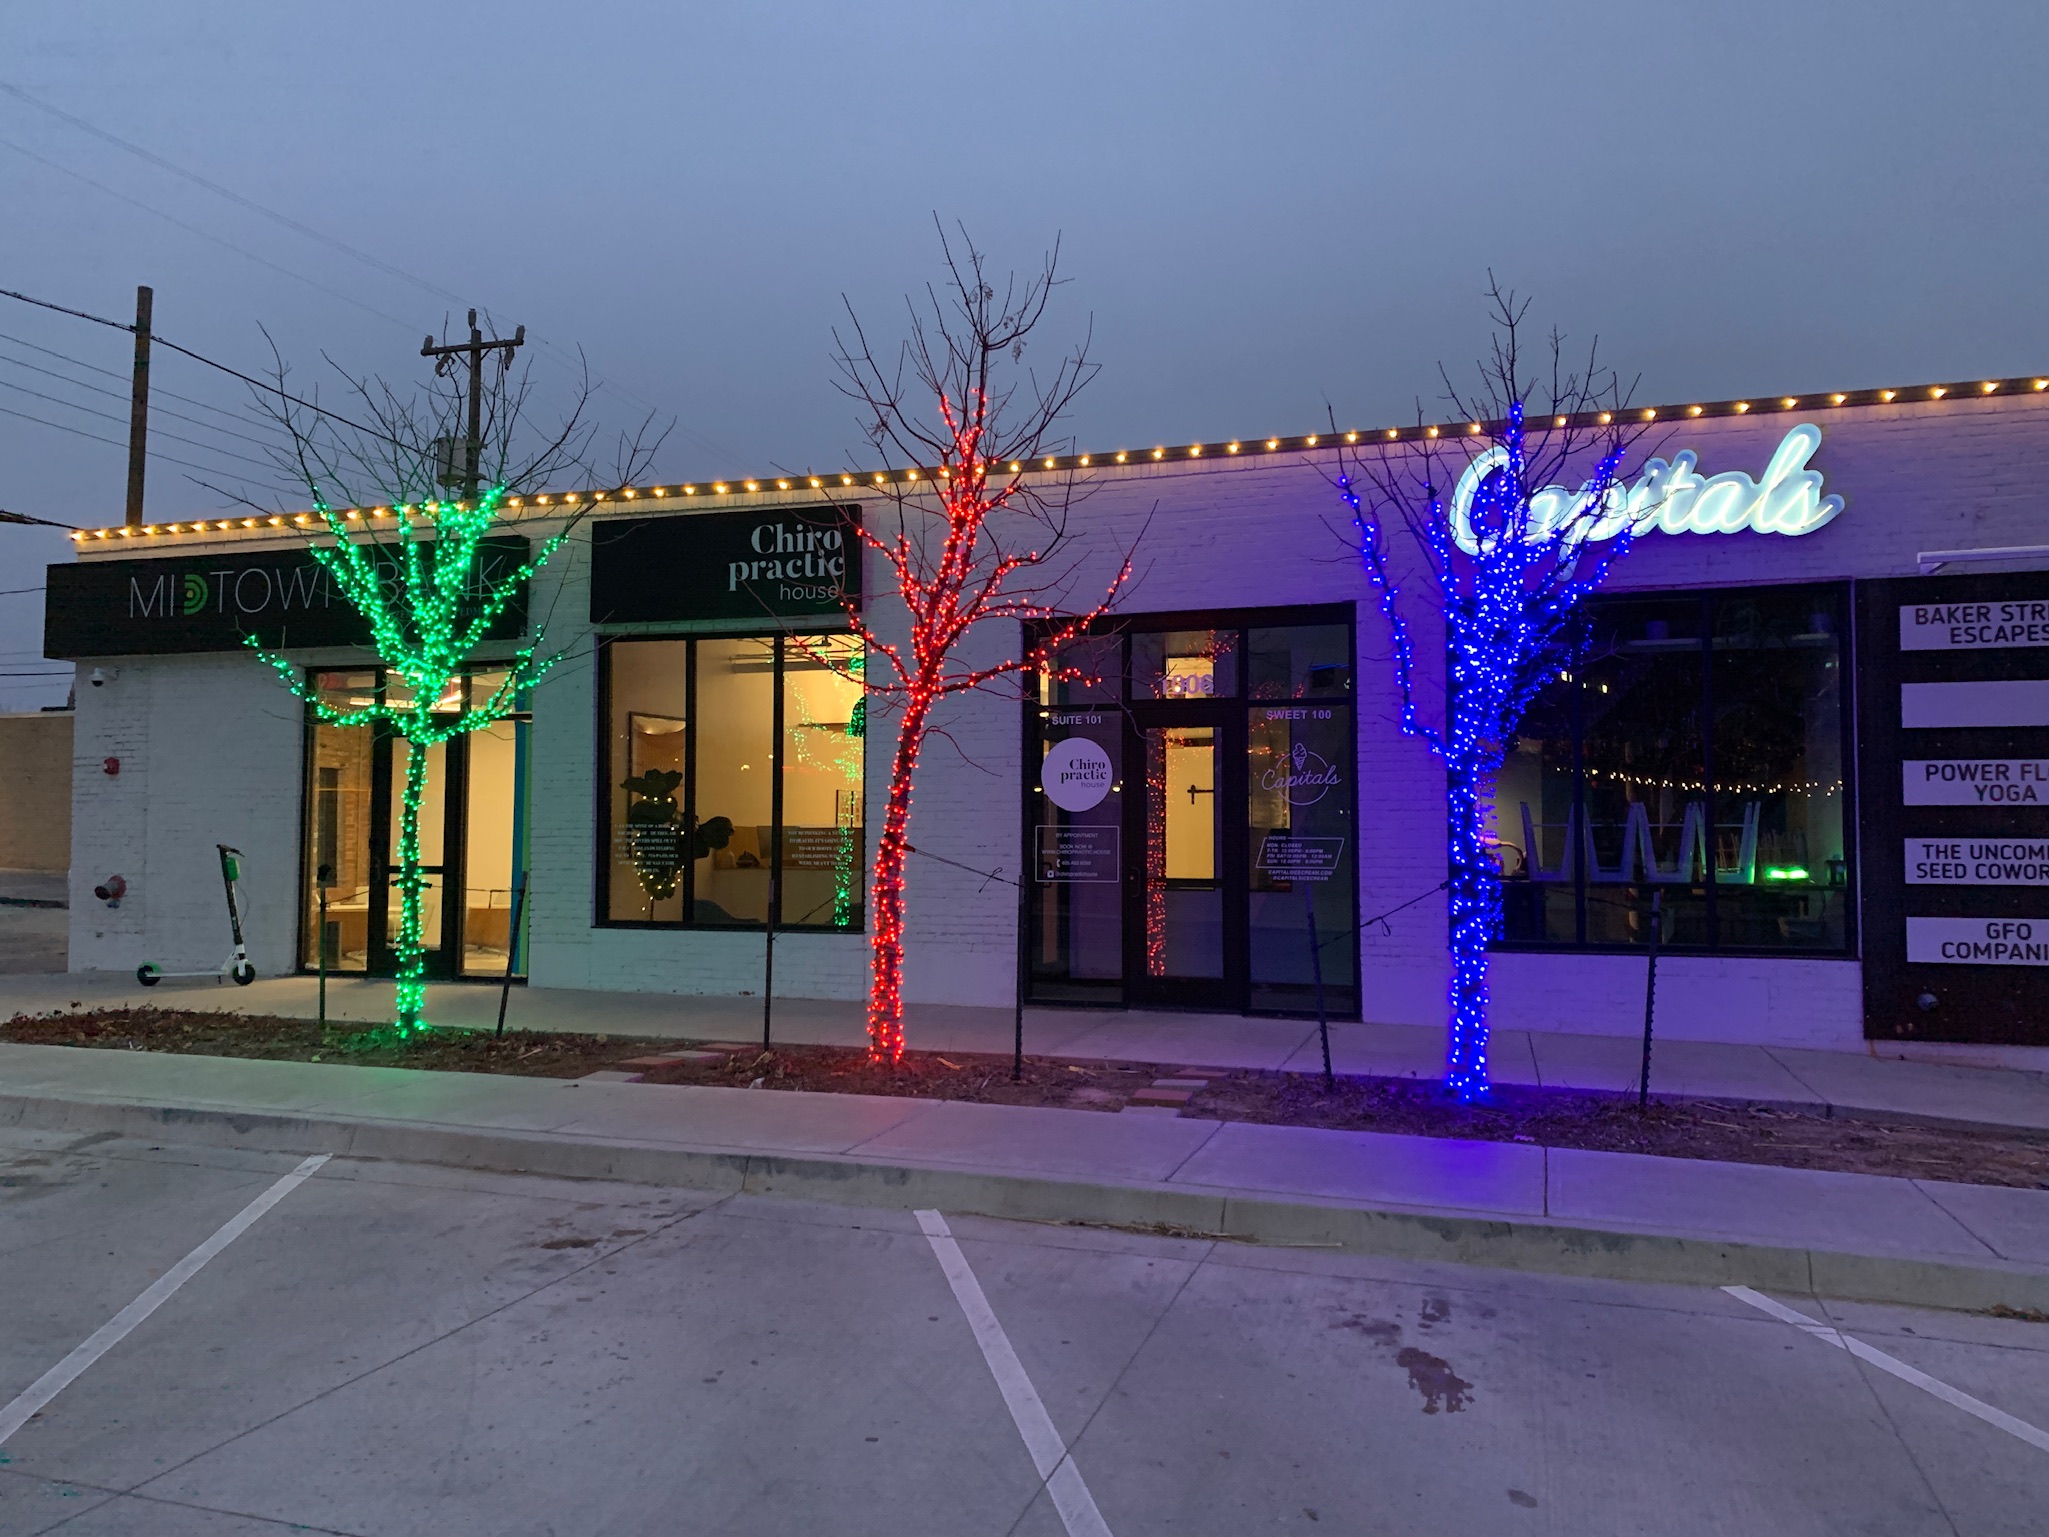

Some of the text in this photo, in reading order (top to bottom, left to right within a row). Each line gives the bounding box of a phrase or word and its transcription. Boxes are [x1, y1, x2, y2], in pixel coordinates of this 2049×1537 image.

[1450, 423, 1845, 581] Capitals
[751, 523, 842, 555] Chiro
[728, 549, 844, 592] practic
[779, 583, 839, 601] house
[1915, 603, 2049, 625] BAKER STR
[1950, 624, 2049, 644] ESCAPES
[1051, 714, 1102, 726] SUITE 101
[1265, 709, 1332, 720] SWEET 100
[1069, 758, 1106, 771] Chiro
[1926, 763, 2049, 782] POWER FL
[1060, 768, 1107, 785] practic
[1261, 764, 1342, 792] Capitals
[1973, 784, 2038, 802] YOGA
[1922, 844, 2049, 860] THE UNCOM
[1916, 863, 2049, 880] SEED COWOR
[1986, 922, 2032, 940] GFO
[1941, 941, 2049, 961] COMPANI
